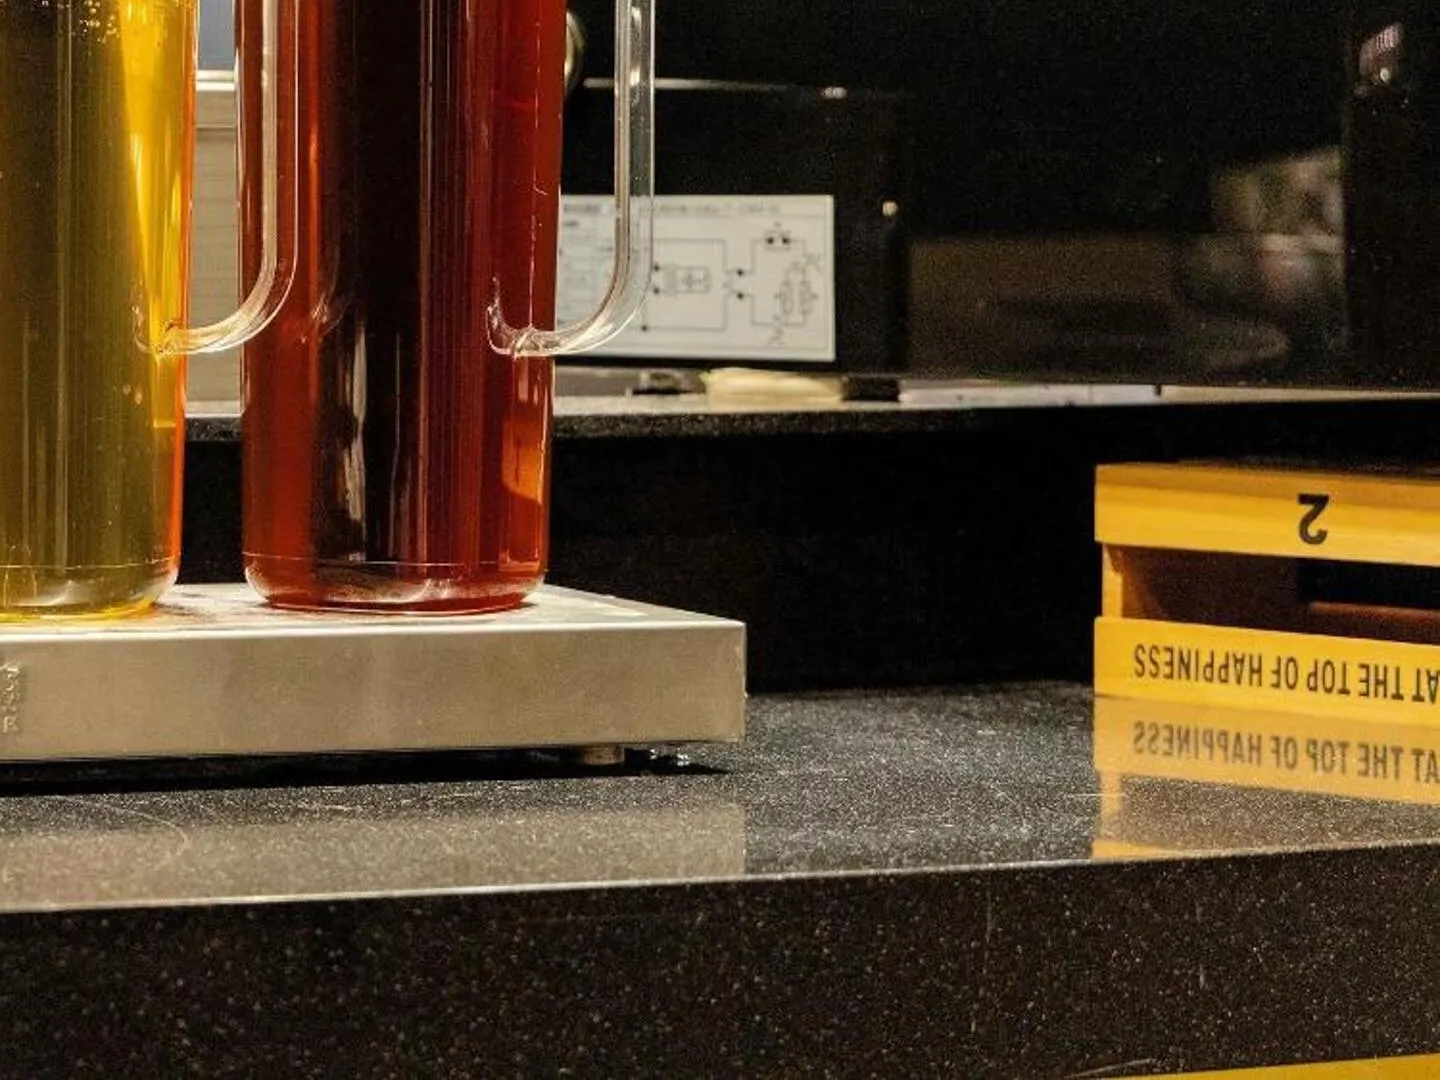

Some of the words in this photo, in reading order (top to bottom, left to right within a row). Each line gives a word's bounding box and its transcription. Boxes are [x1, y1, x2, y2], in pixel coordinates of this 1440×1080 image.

[1297, 493, 1330, 545] 2
[1134, 643, 1263, 687] HAPPINESS
[1271, 655, 1299, 690] OF
[1307, 659, 1351, 697] TOP
[1358, 663, 1404, 701] THE
[1412, 667, 1440, 705] AT
